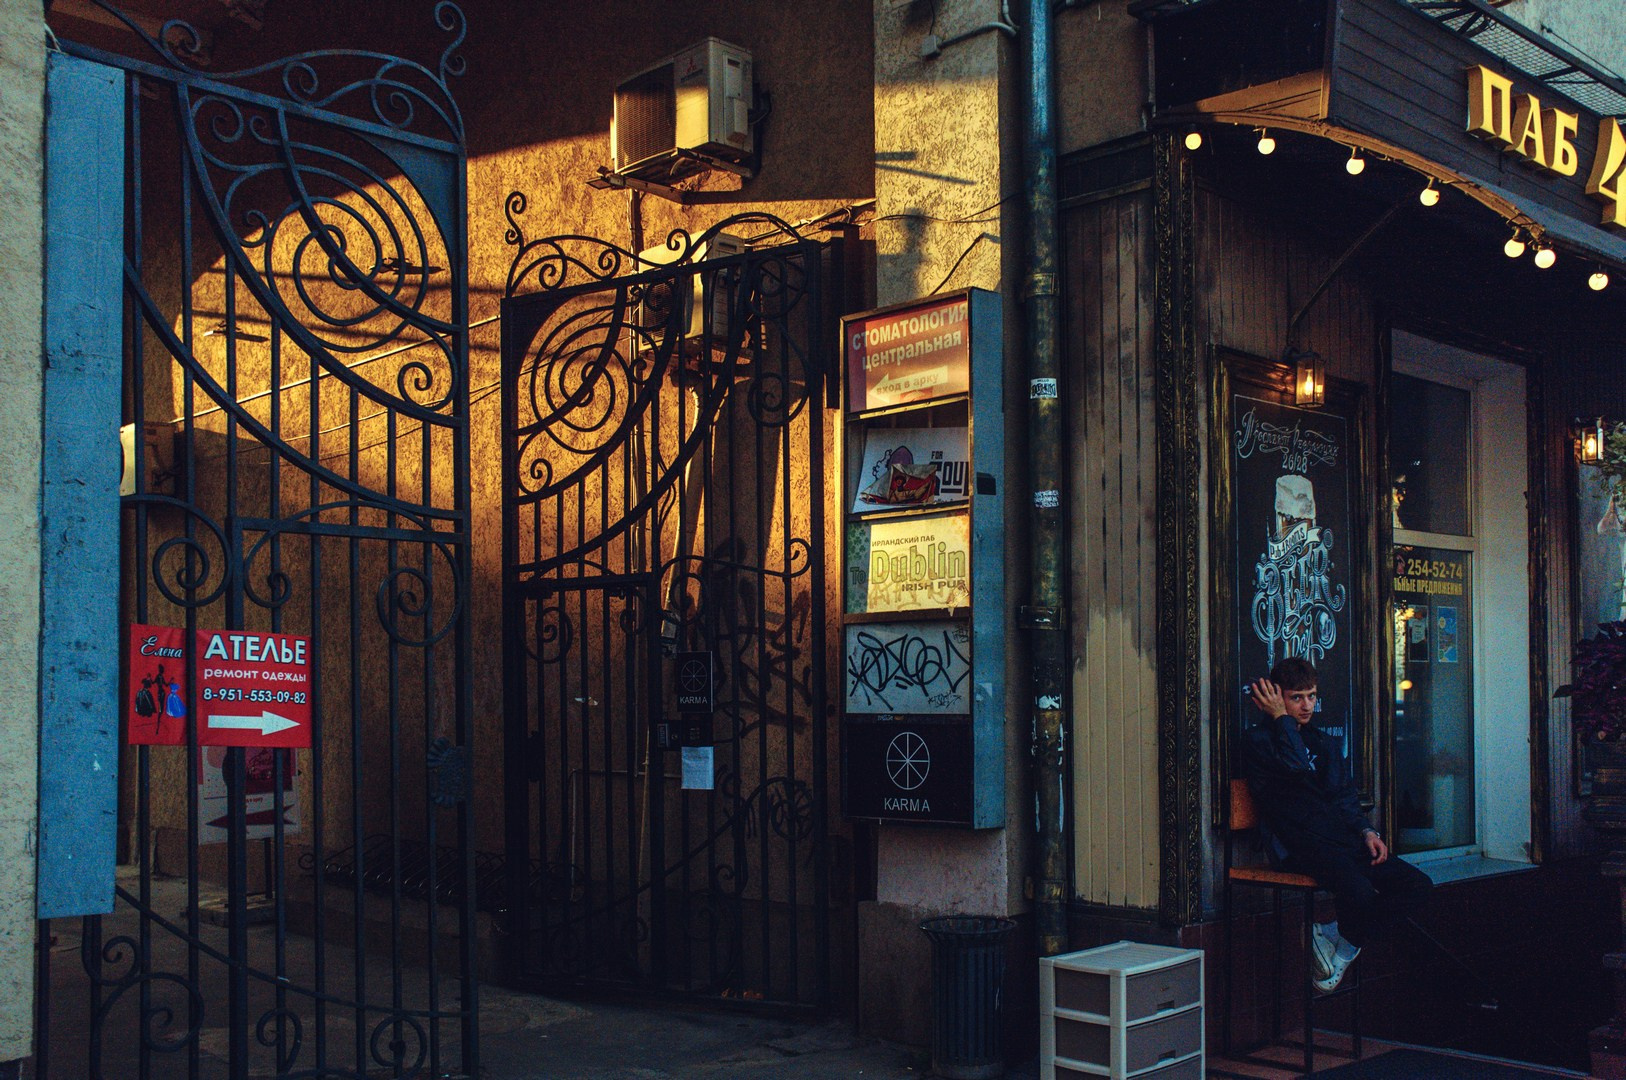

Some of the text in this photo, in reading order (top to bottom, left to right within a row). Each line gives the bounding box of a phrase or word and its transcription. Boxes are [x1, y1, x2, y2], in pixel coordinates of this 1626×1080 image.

[1470, 64, 1579, 177] ПАБ
[853, 303, 968, 351] СТОМАТОЛОГИЯ
[862, 330, 962, 372] центральная
[876, 382, 902, 396] вход
[931, 450, 944, 460] FOR
[871, 534, 936, 547] ИРЛАНДСКИЙ ПАБ
[871, 541, 967, 585] Dublin
[1407, 558, 1463, 581] 254-52-74
[901, 581, 934, 592] IRISH
[140, 635, 184, 659] Елена
[204, 633, 307, 665] АТЕЛЬЕ
[204, 668, 307, 683] ремонт одежды
[203, 688, 307, 705] 8-951-553-09-82
[679, 696, 708, 705] KARMA
[884, 797, 931, 813] KARMA
